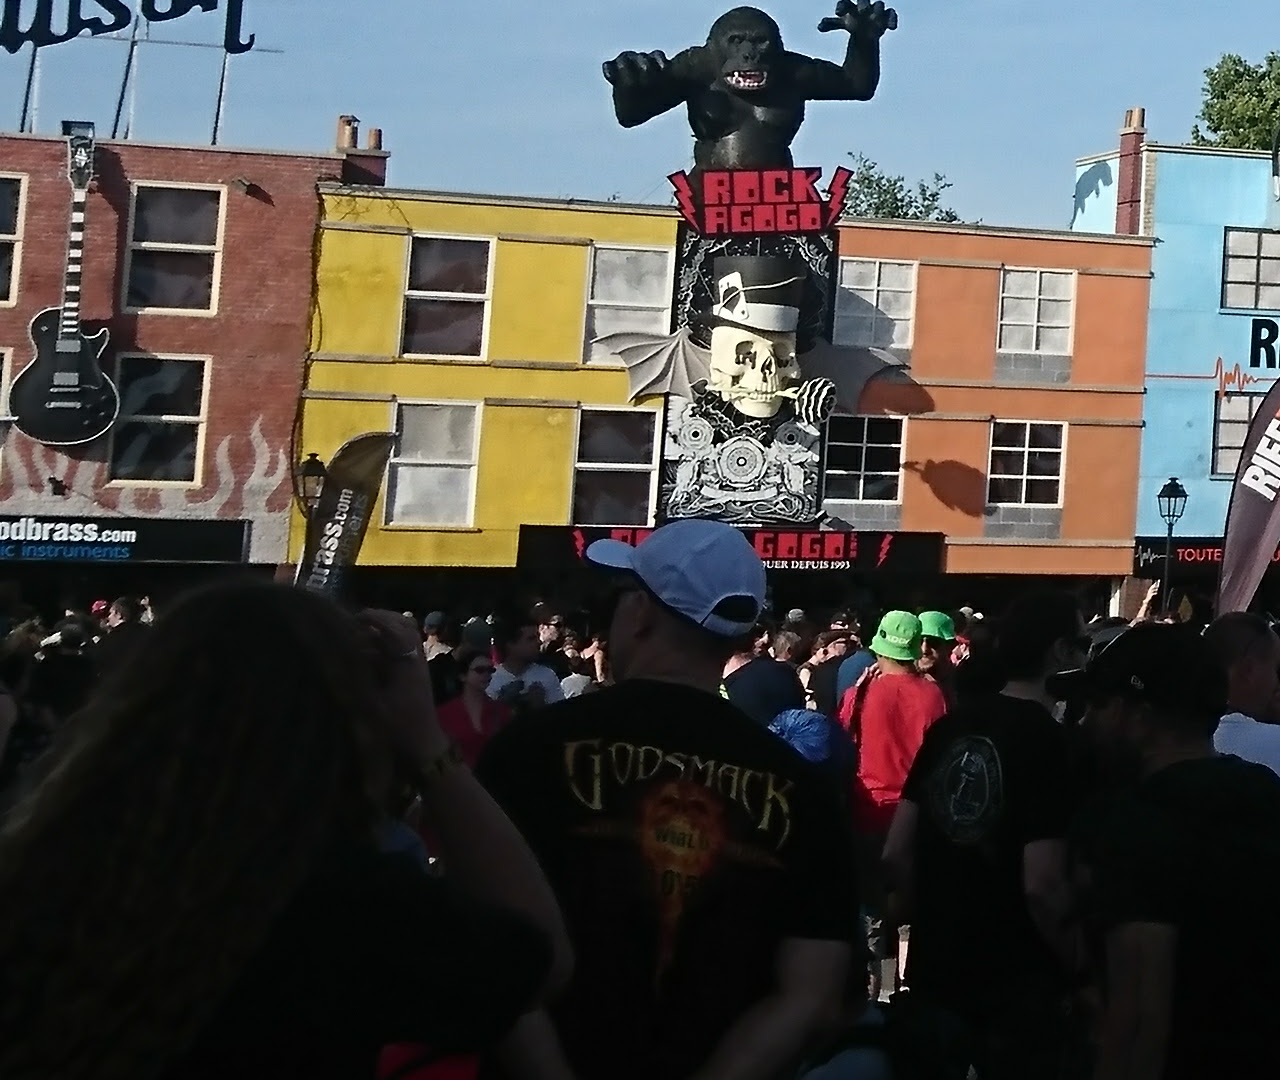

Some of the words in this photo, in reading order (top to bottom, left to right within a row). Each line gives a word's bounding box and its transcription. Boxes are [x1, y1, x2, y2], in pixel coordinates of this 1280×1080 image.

[703, 171, 821, 204] ROCK
[704, 203, 822, 234] AGOGO
[22, 543, 130, 558] instruments
[790, 560, 829, 570] DEPUIS
[830, 560, 851, 570] 1993
[562, 738, 796, 850] GODSMACK
